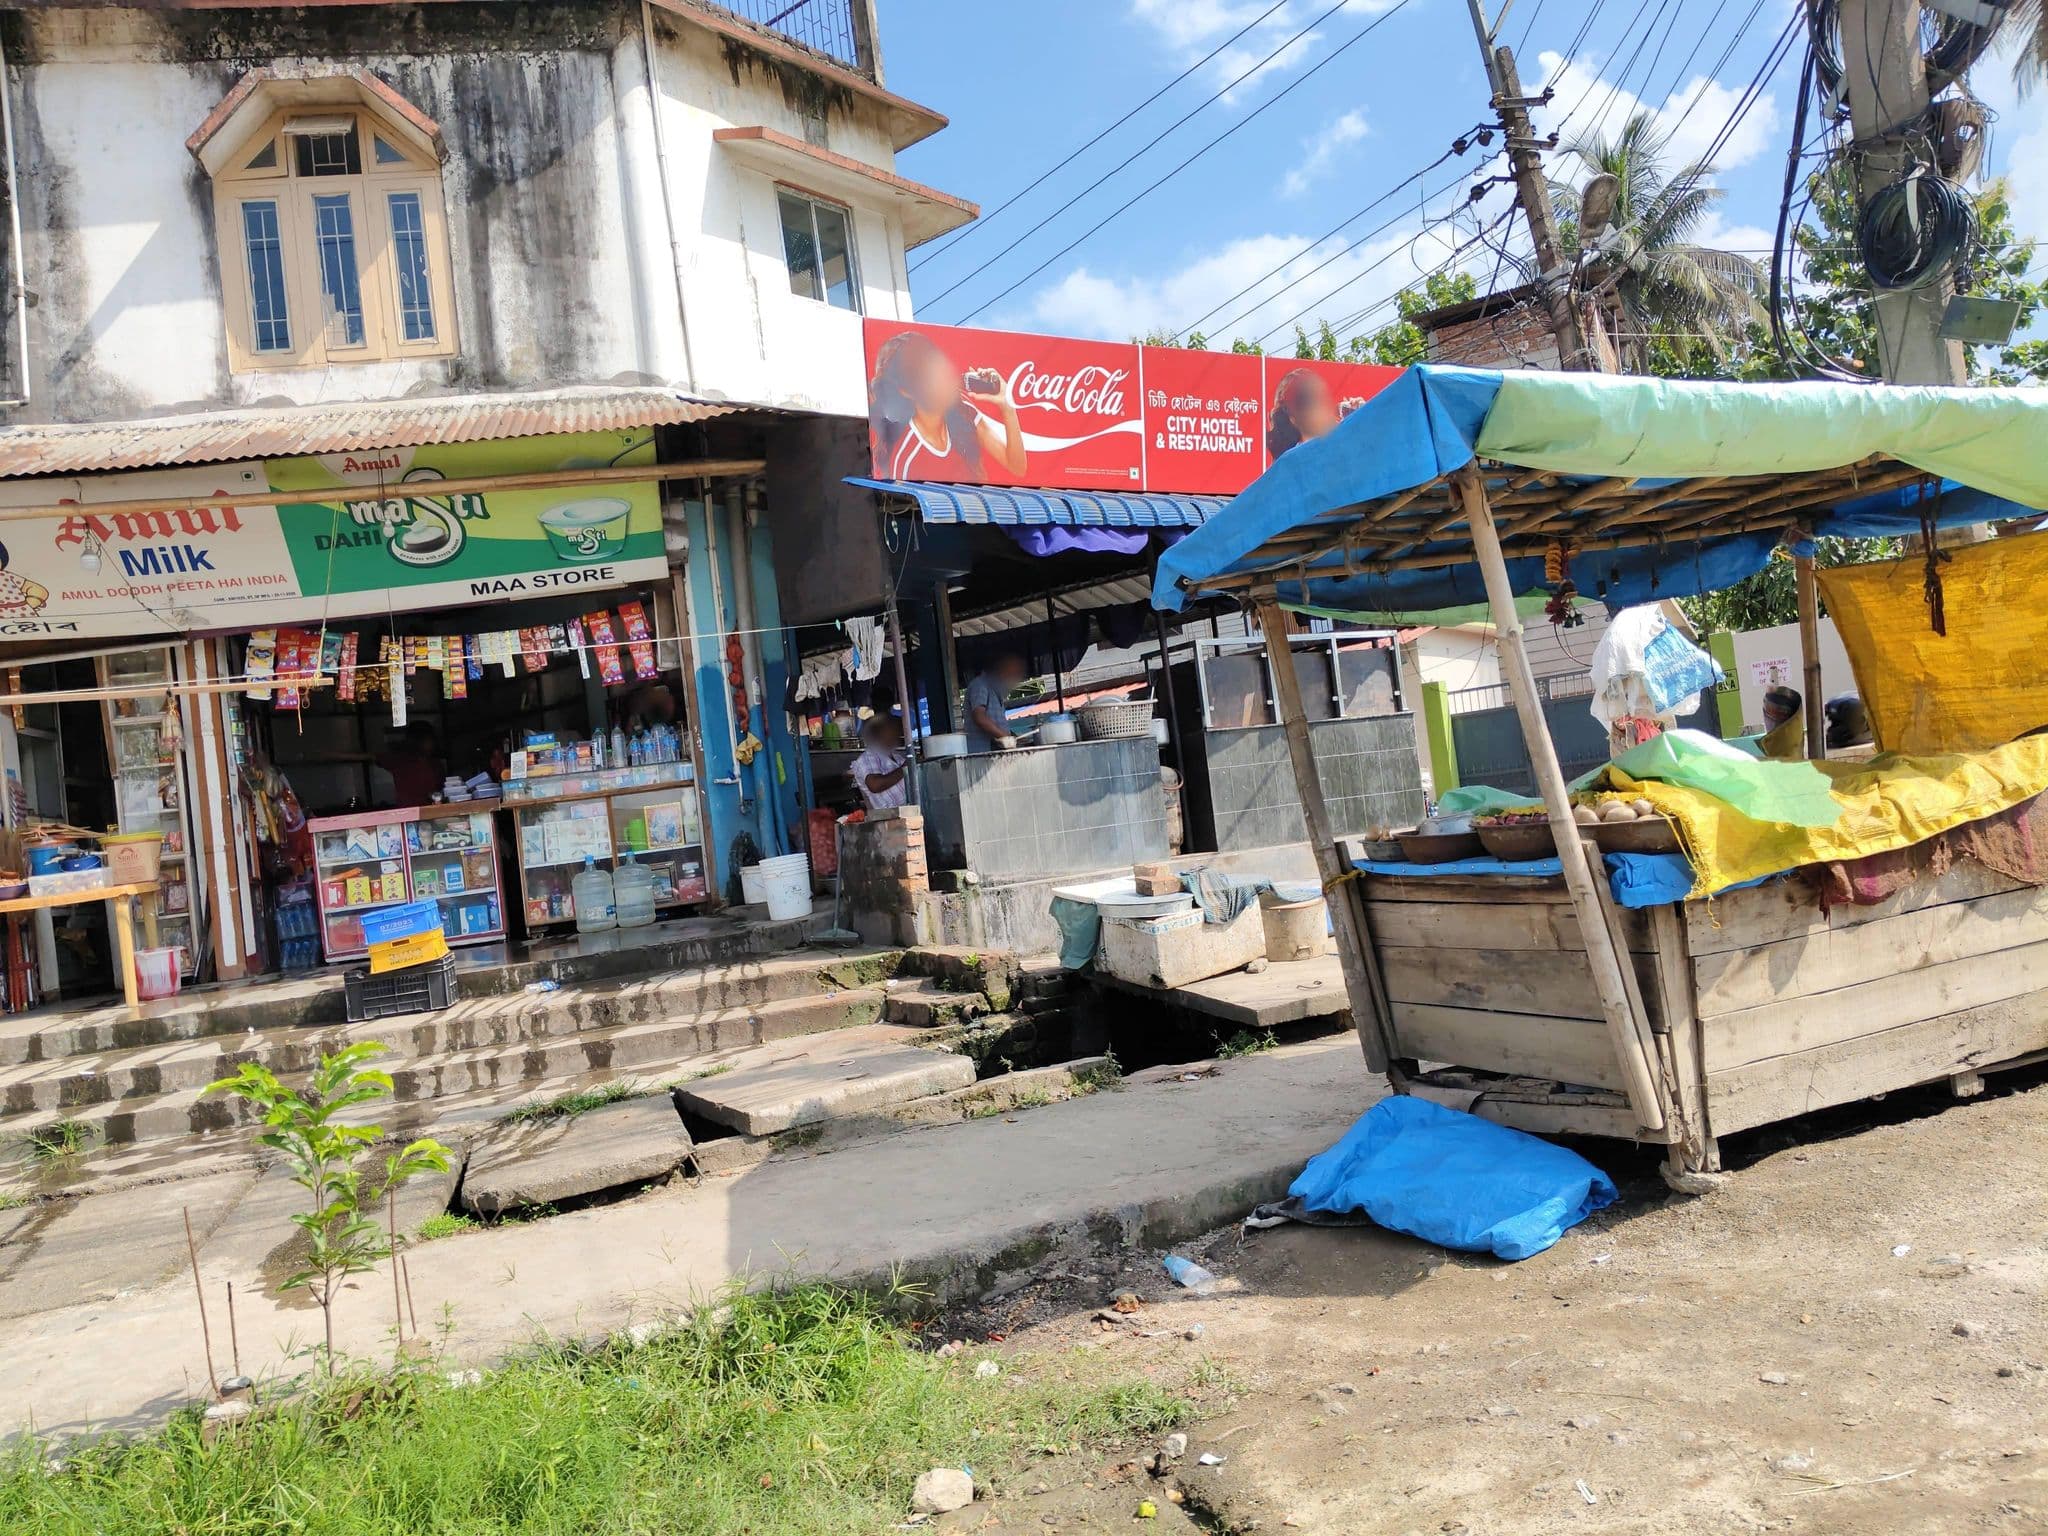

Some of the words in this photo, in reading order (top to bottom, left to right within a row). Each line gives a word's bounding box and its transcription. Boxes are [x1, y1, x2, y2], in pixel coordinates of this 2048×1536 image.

[1006, 361, 1130, 416] Coca-Cola
[1148, 389, 1168, 408] চিটি
[1171, 394, 1202, 411] হোটেল
[1167, 415, 1197, 433] CITY
[1200, 417, 1243, 435] HOTEL
[1156, 432, 1165, 448] &
[1168, 433, 1254, 453] RESTAURANT
[342, 454, 401, 473] Amul
[55, 489, 244, 552] Amul
[314, 530, 383, 551] DAHI
[119, 544, 216, 577] Milk
[61, 590, 103, 601] AMUL
[168, 580, 215, 594] PEETA
[218, 577, 243, 588] HAI
[247, 574, 288, 586] INDIA
[470, 578, 526, 596] MAA
[532, 567, 616, 588] STORE
